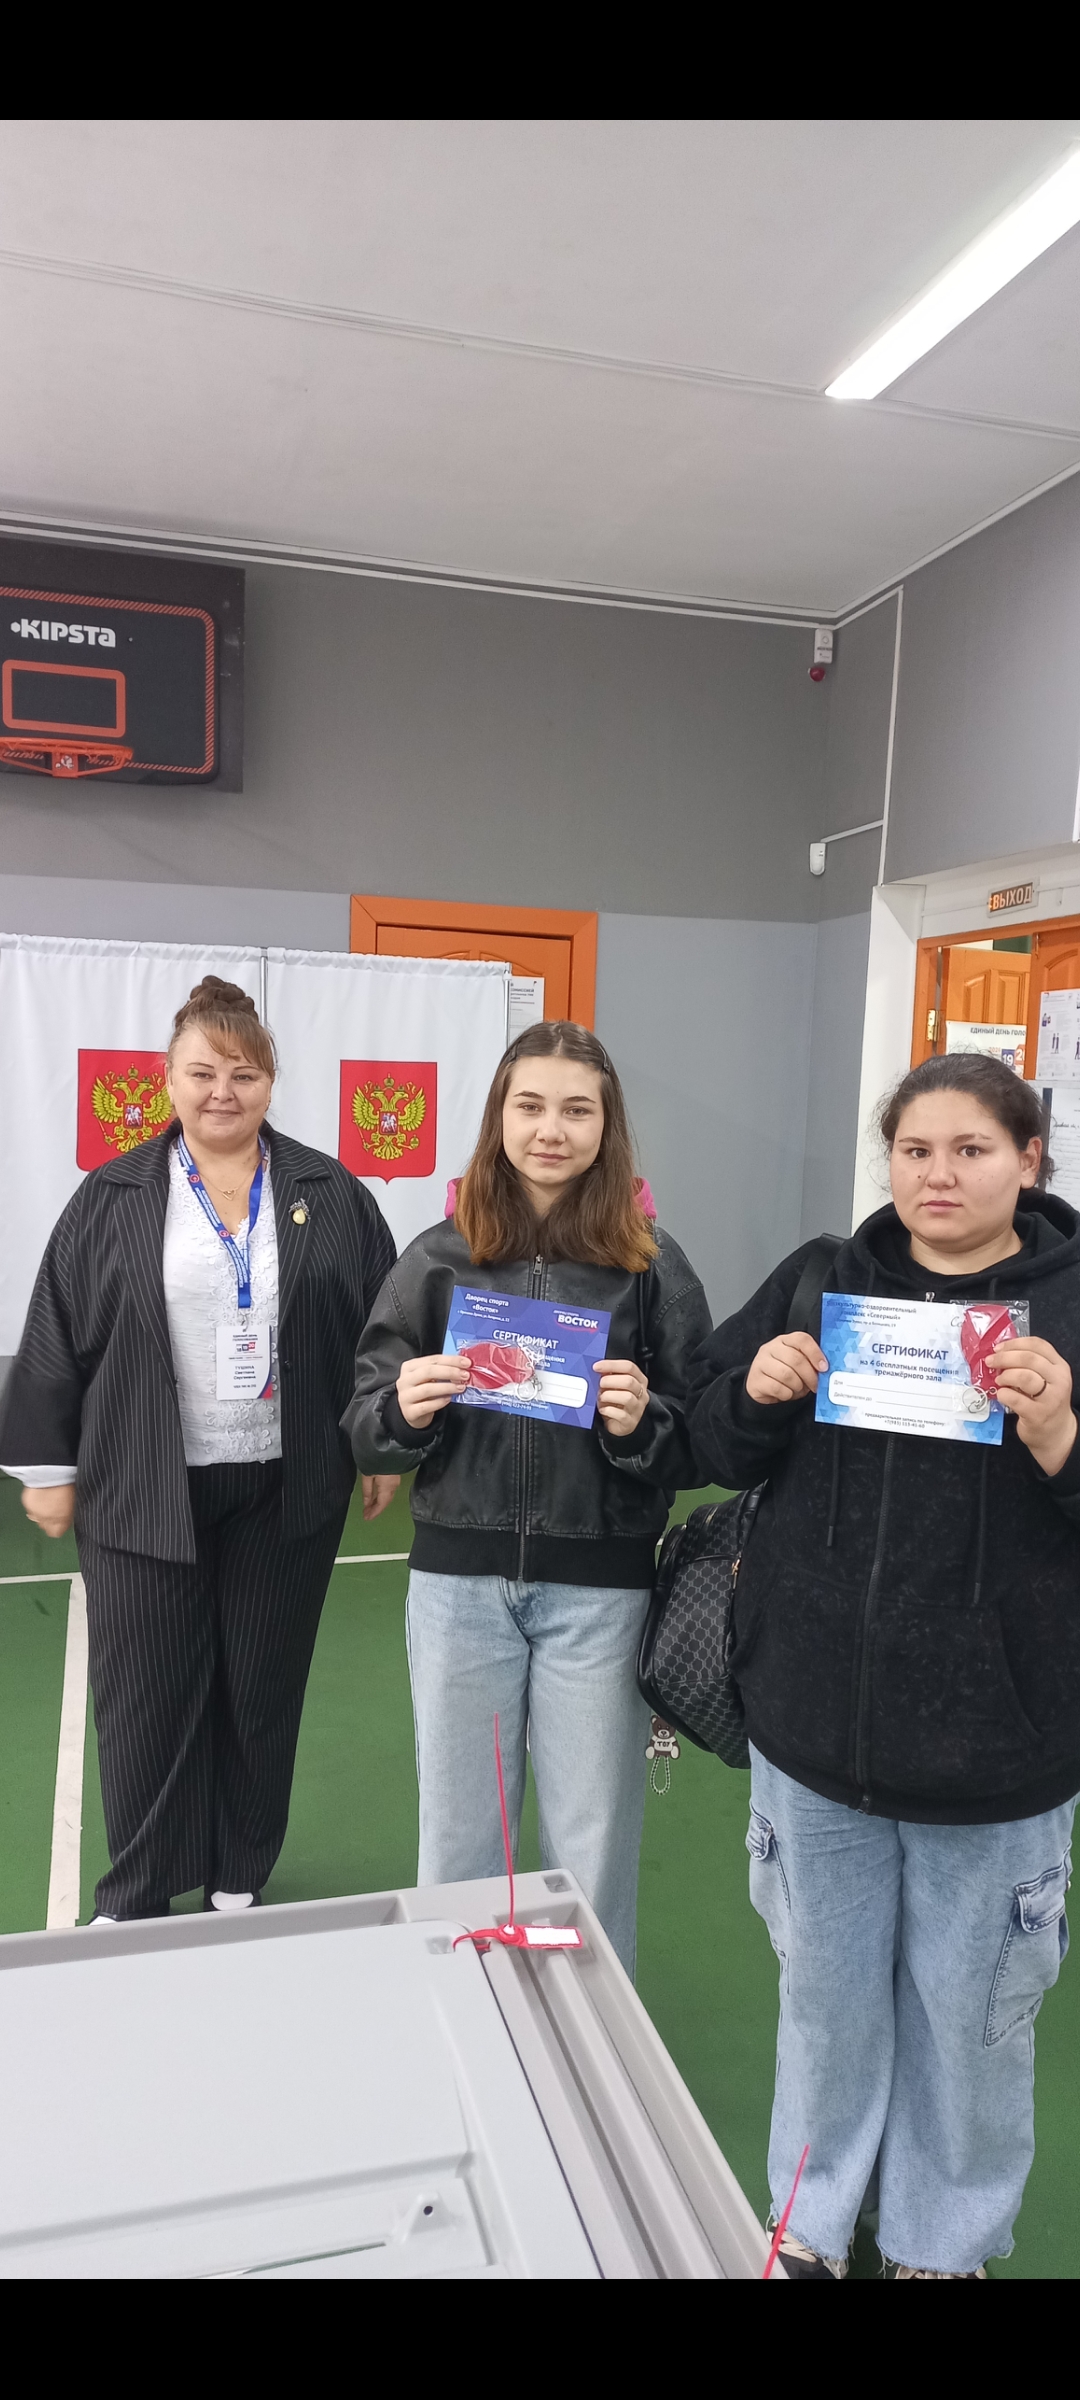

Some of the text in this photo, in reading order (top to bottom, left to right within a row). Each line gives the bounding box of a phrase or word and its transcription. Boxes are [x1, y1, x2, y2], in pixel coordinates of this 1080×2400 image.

[992, 884, 1032, 911] ВЫХОД
[970, 1027, 995, 1035] ЕДИНЫЙ
[995, 1028, 1010, 1036] ДЕНЬ
[1002, 1053, 1014, 1066] 19
[465, 1293, 509, 1307] Дворец спорта
[472, 1303, 499, 1314] «Восток»
[557, 1314, 599, 1329] ВОСТОК
[493, 1329, 559, 1350] СЕРТИФИКАТ
[871, 1342, 949, 1361] СЕРТИФИКАТ
[876, 1360, 918, 1372] бесплатных
[874, 1368, 942, 1382] тренажёрного зала
